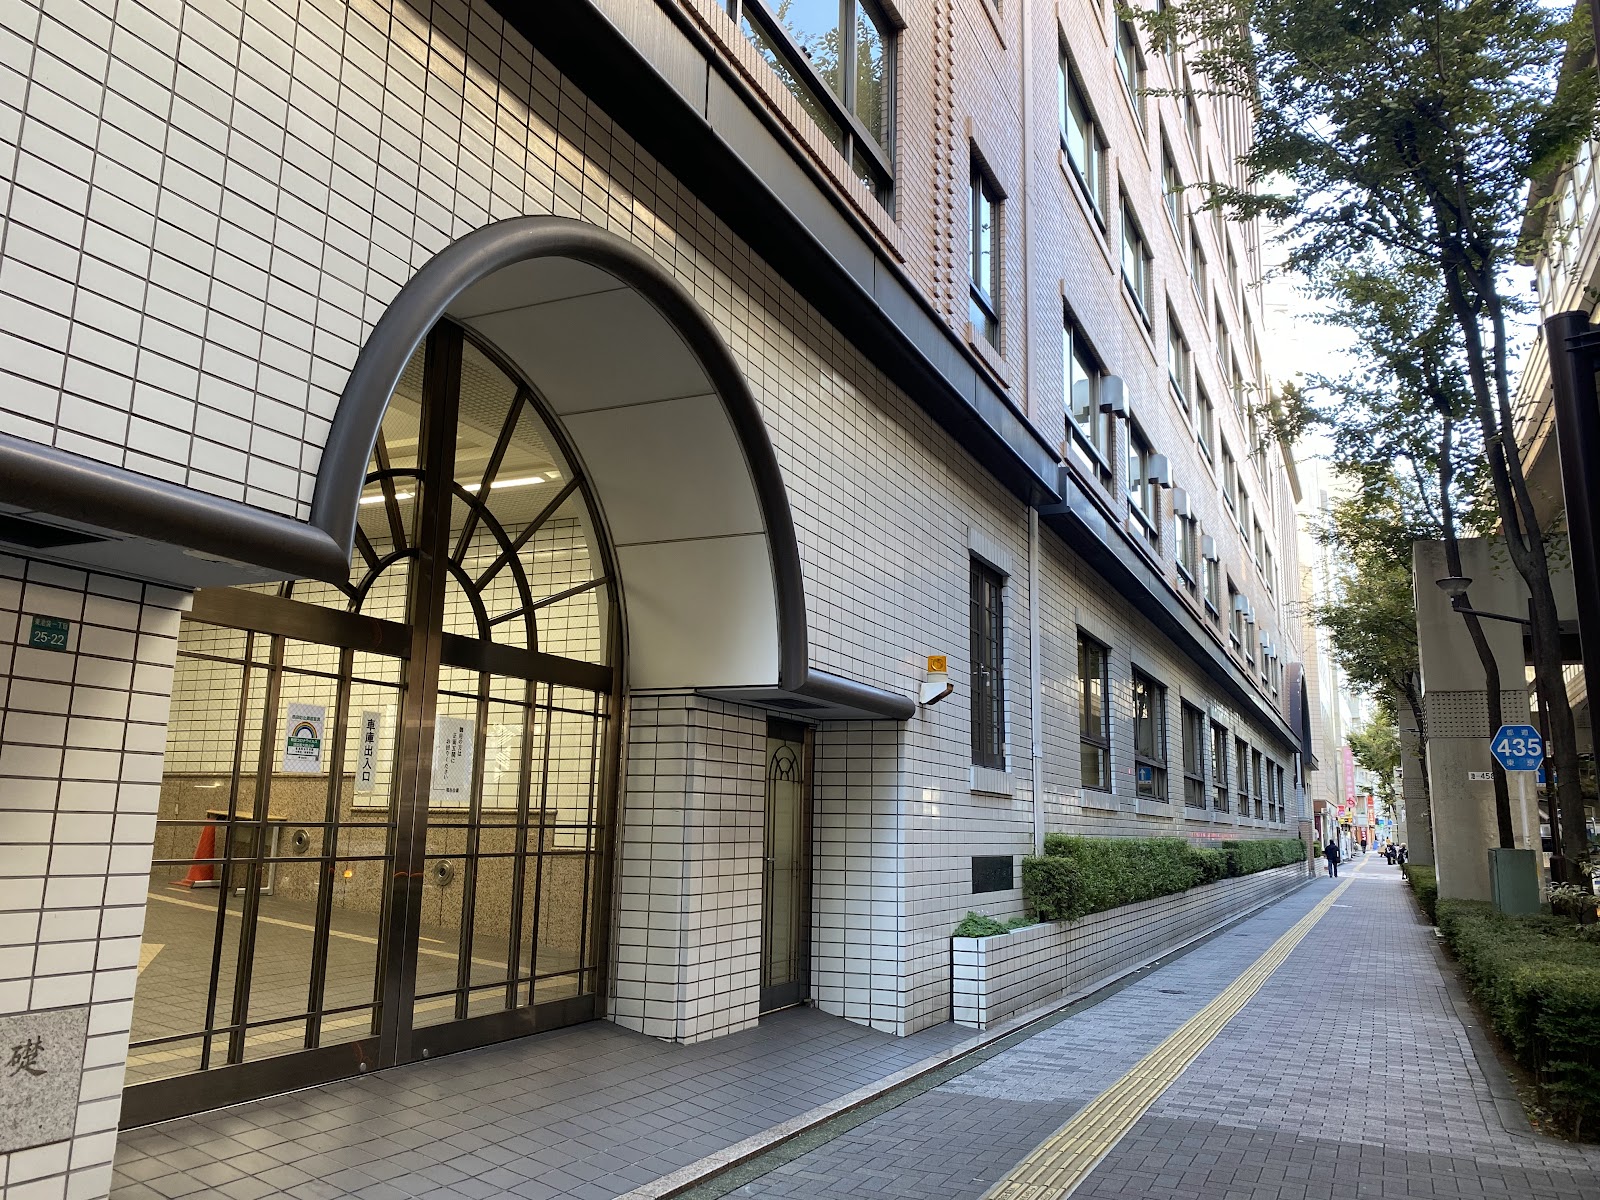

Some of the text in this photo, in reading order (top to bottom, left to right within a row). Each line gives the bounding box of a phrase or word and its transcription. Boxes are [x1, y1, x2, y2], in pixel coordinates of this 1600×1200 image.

[33, 630, 64, 646] 25-22
[361, 718, 376, 782] 車庫出入口
[1497, 738, 1542, 757] 435
[1506, 758, 1536, 767] 東京
[5, 1035, 48, 1077] 礎
